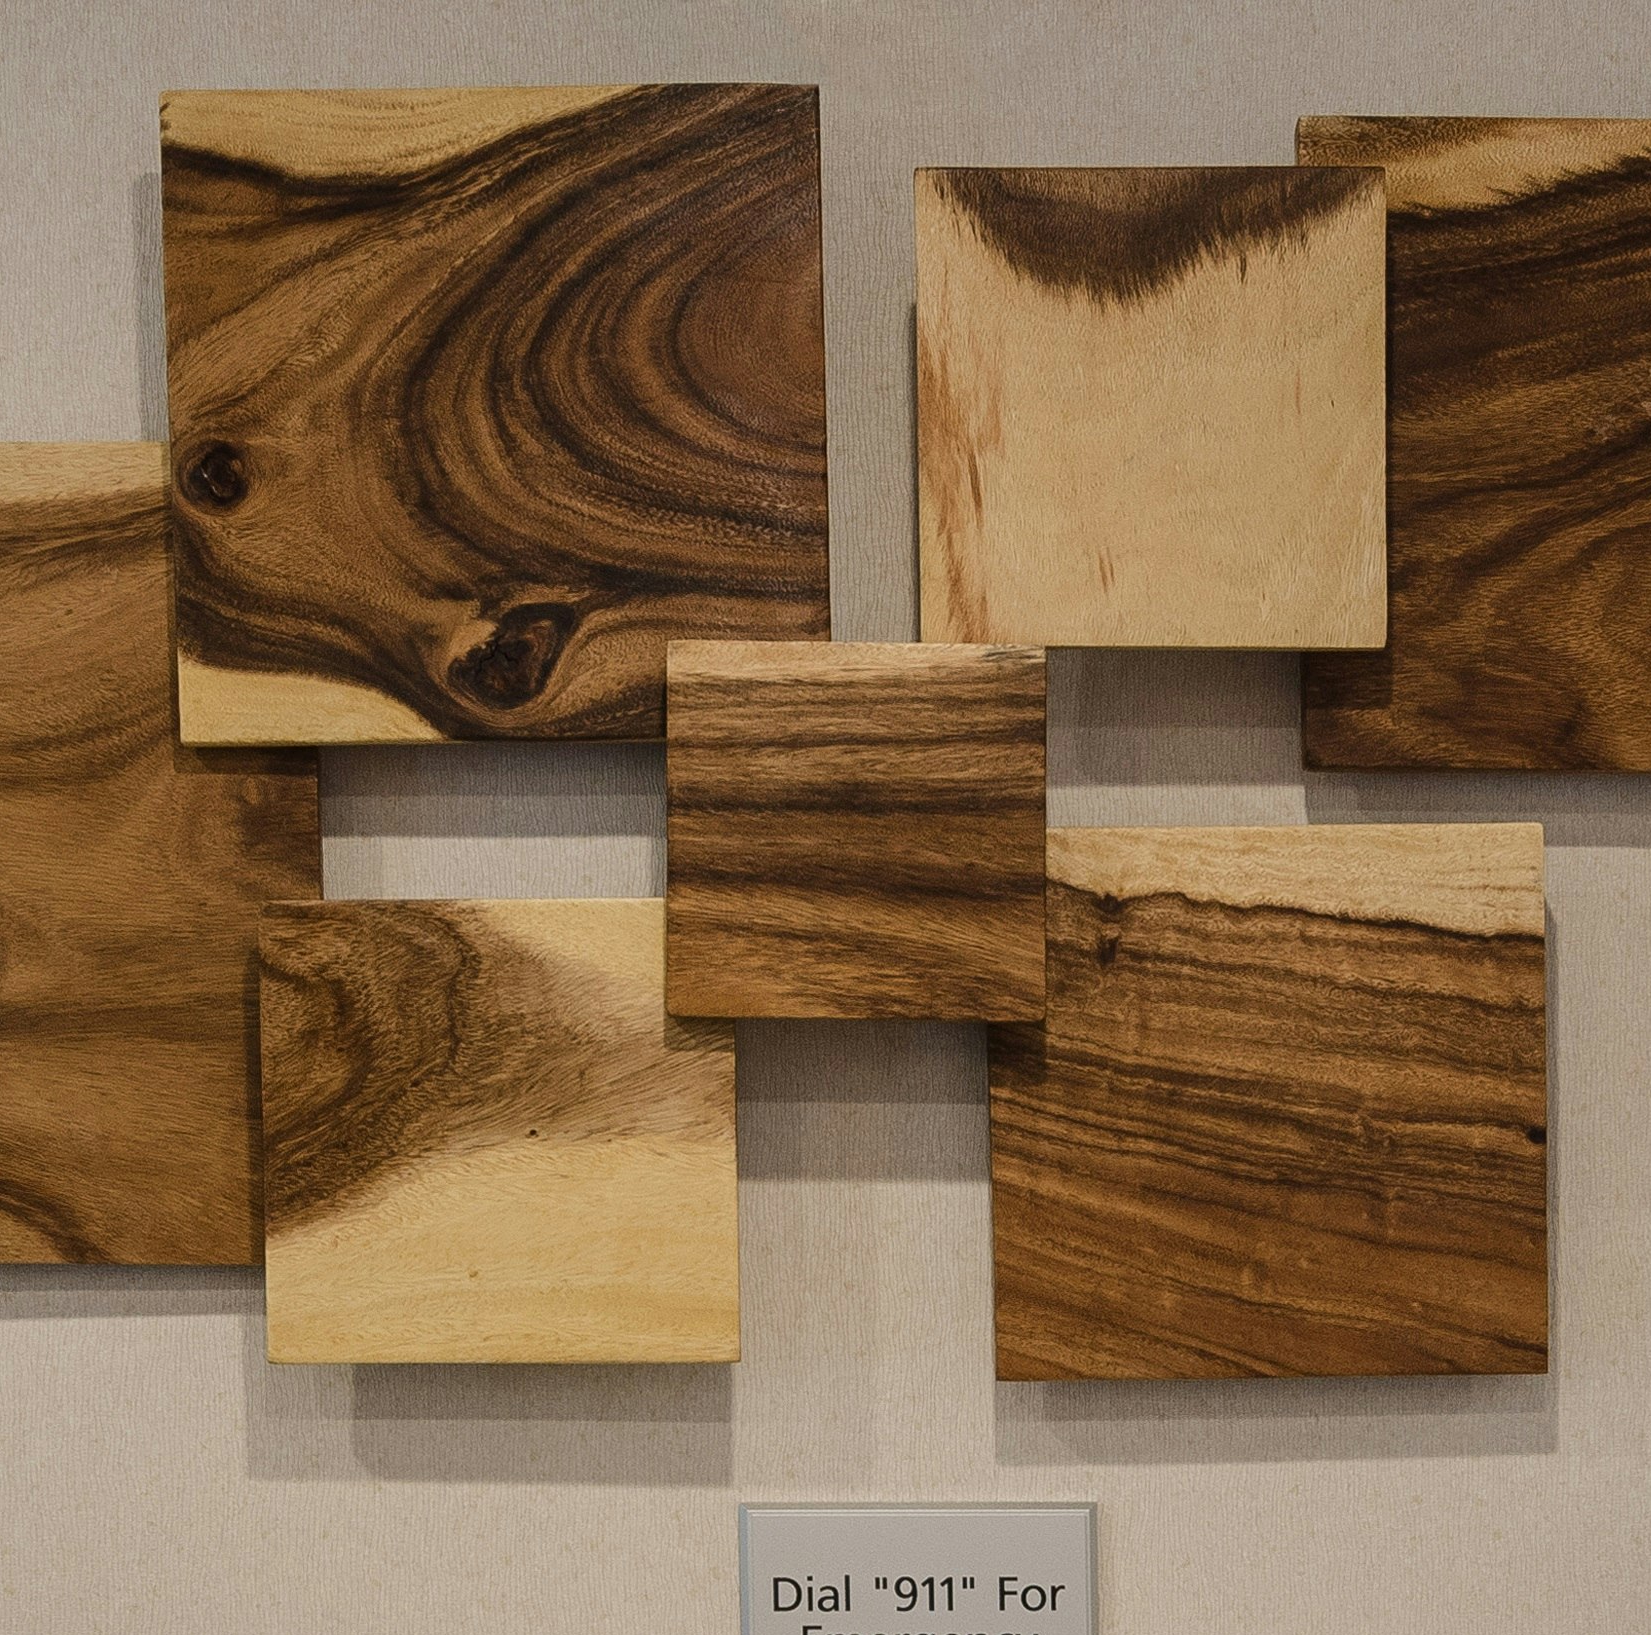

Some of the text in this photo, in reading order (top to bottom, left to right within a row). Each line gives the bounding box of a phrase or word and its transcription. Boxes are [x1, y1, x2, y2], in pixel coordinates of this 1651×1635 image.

[772, 1574, 1066, 1612] Dial "911" For
